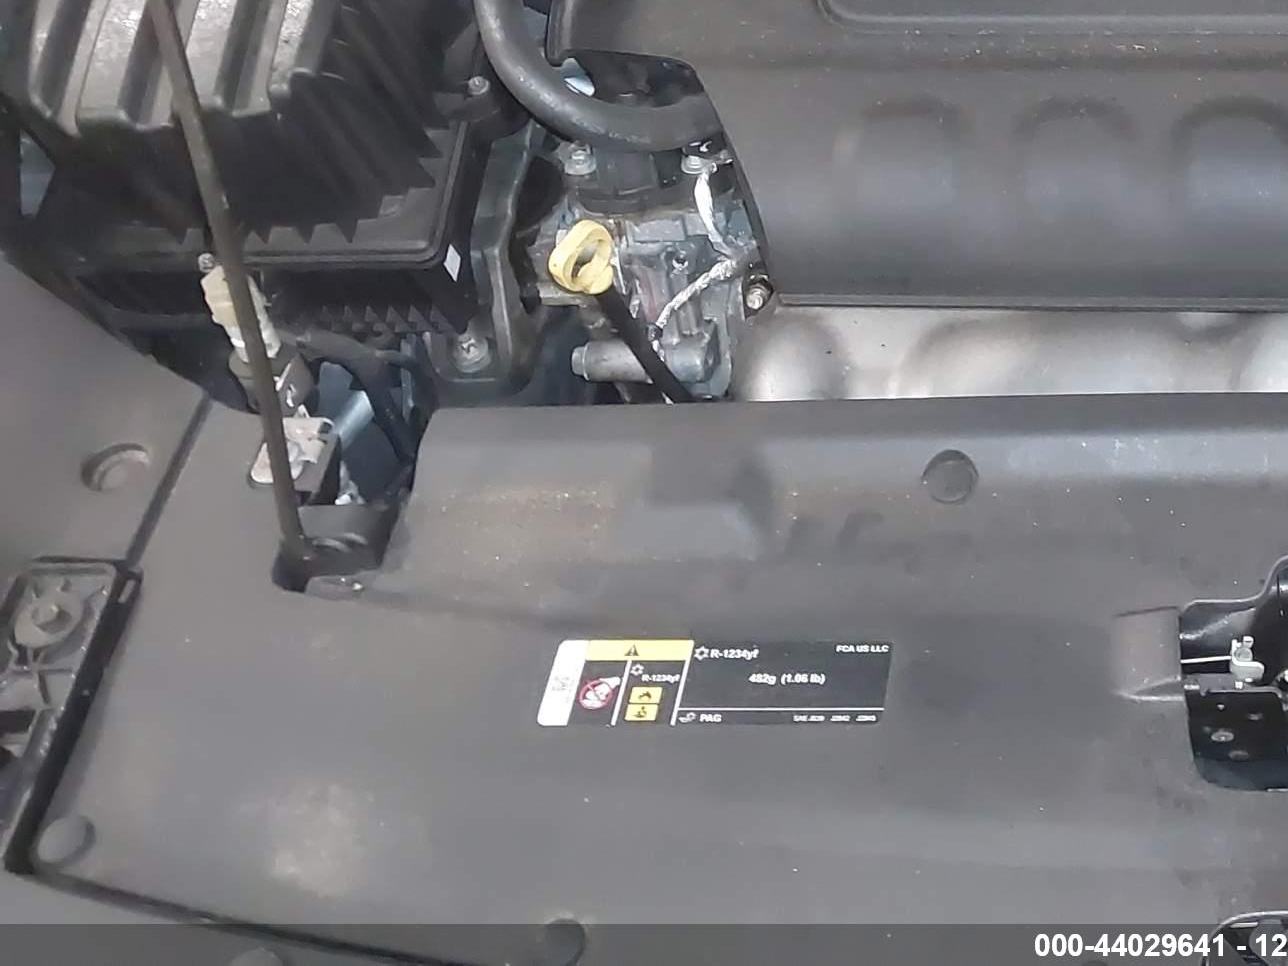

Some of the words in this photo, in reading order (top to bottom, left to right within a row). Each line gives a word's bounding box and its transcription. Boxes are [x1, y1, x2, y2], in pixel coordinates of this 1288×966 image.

[836, 644, 855, 652] FCA
[855, 644, 870, 652] US
[870, 644, 889, 652] LLC
[709, 648, 760, 661] R-1234yf
[641, 673, 681, 684] R-1234yf
[809, 673, 826, 685] lb)
[699, 713, 723, 722] PAG
